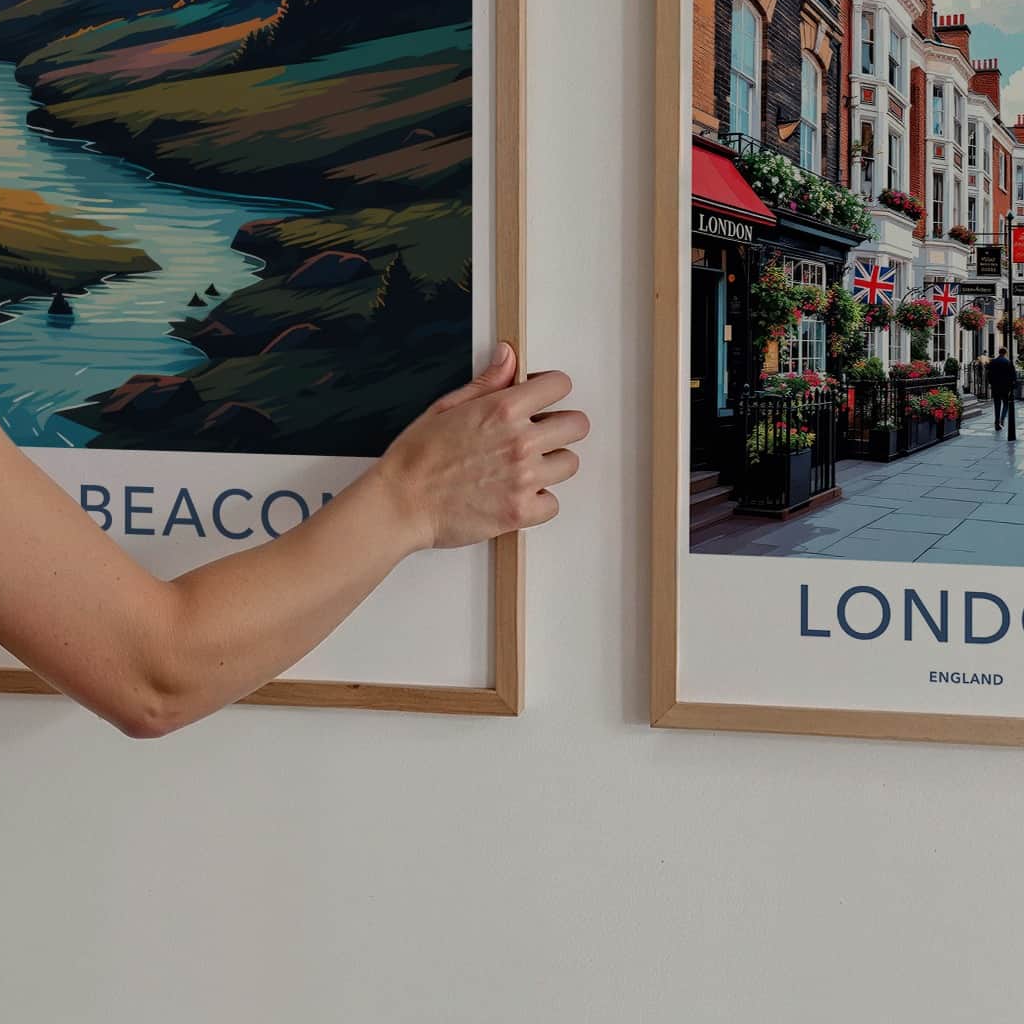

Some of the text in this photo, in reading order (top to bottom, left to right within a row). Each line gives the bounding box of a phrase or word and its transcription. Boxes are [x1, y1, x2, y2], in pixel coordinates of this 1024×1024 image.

[698, 213, 753, 242] LONDON
[80, 484, 333, 540] BEACO
[799, 583, 1024, 645] LOND
[929, 670, 1004, 686] ENGLAND
